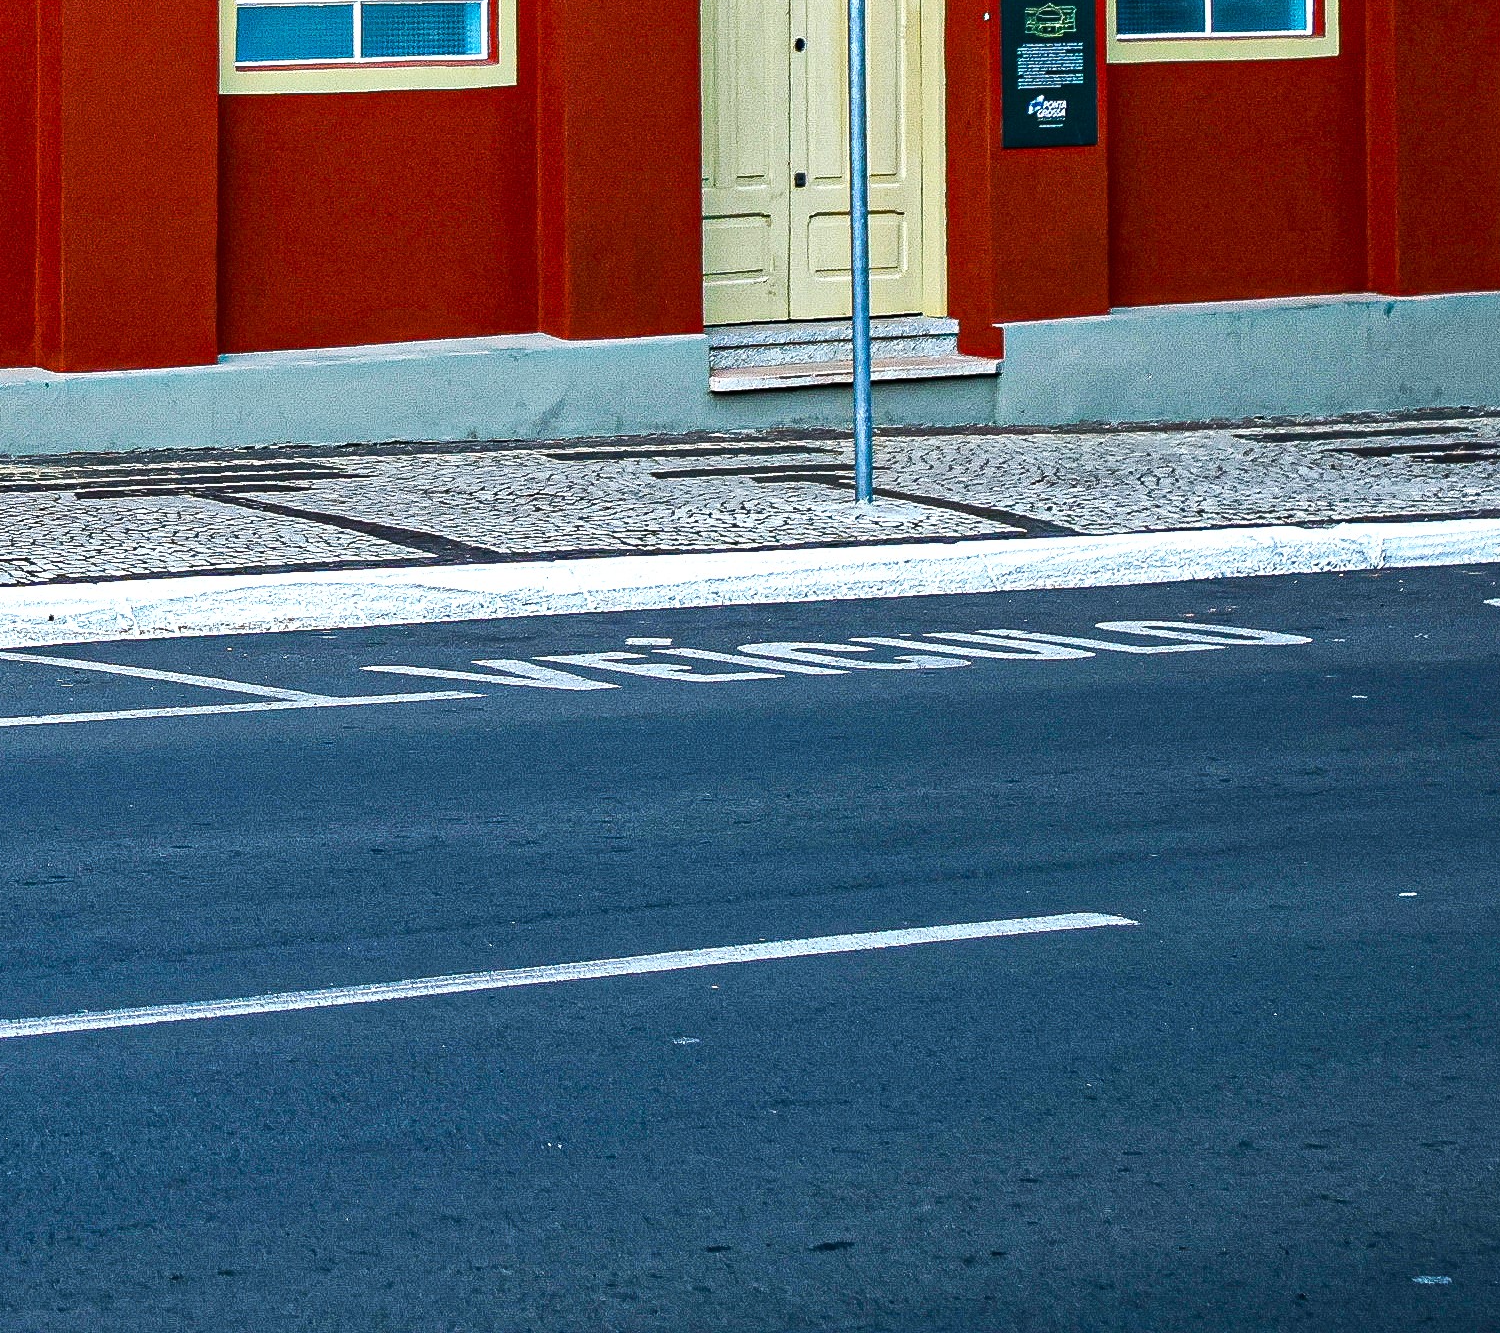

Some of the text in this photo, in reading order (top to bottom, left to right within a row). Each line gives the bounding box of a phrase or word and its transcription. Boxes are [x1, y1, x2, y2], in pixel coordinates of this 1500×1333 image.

[1042, 100, 1067, 109] PONTA
[1036, 108, 1066, 118] GROSSA
[358, 619, 1315, 691] VEÍCULO
